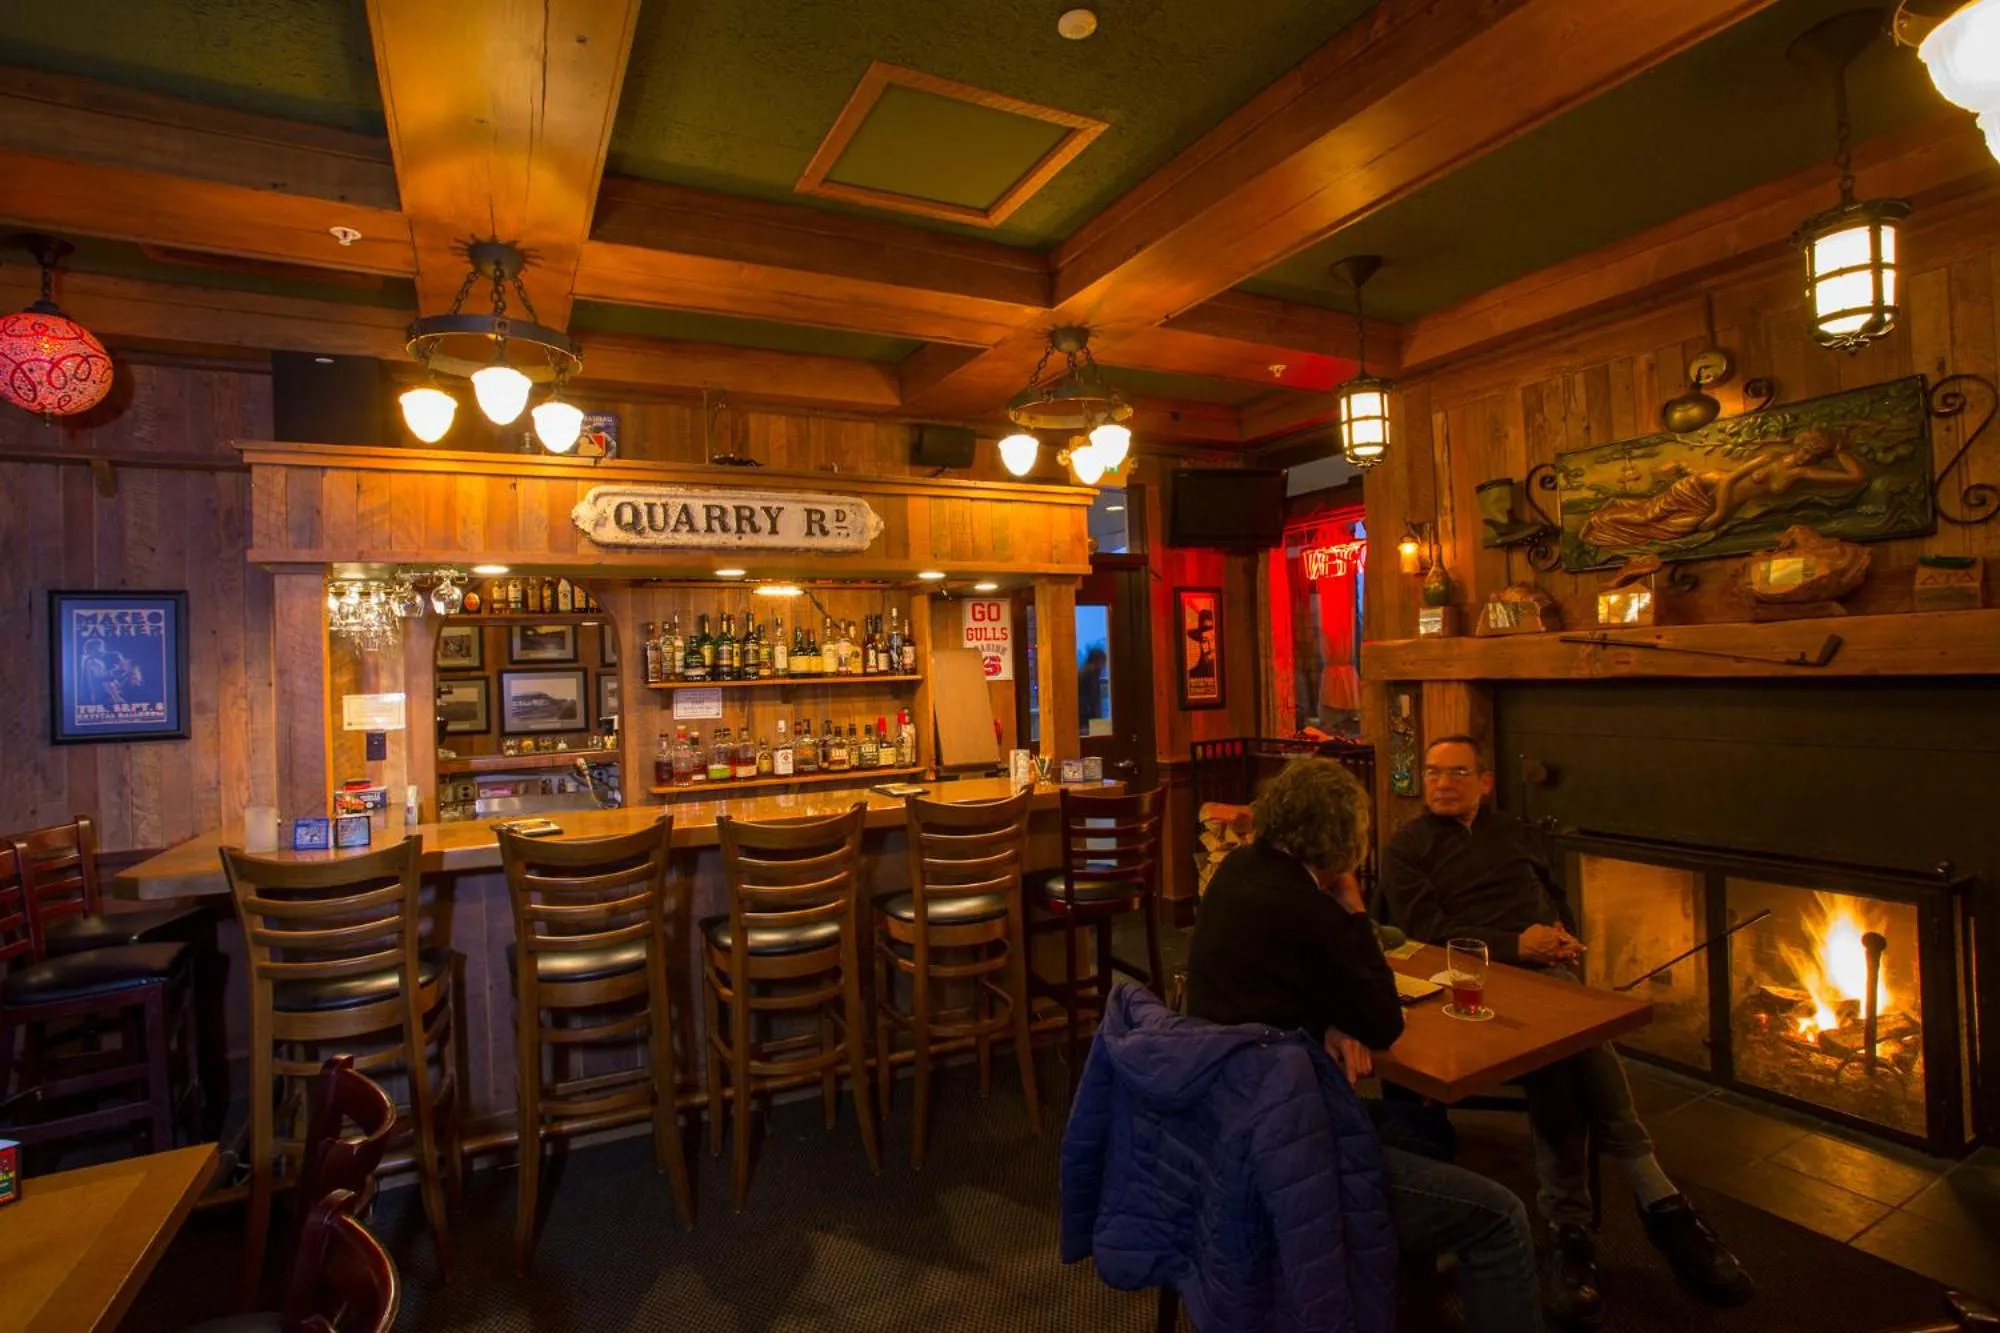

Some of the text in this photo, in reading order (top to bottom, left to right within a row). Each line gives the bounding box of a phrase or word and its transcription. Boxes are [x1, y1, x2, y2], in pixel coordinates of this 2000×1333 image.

[613, 501, 784, 536] QUARRY
[971, 602, 1002, 622] GO
[966, 627, 1009, 641] GULLS
